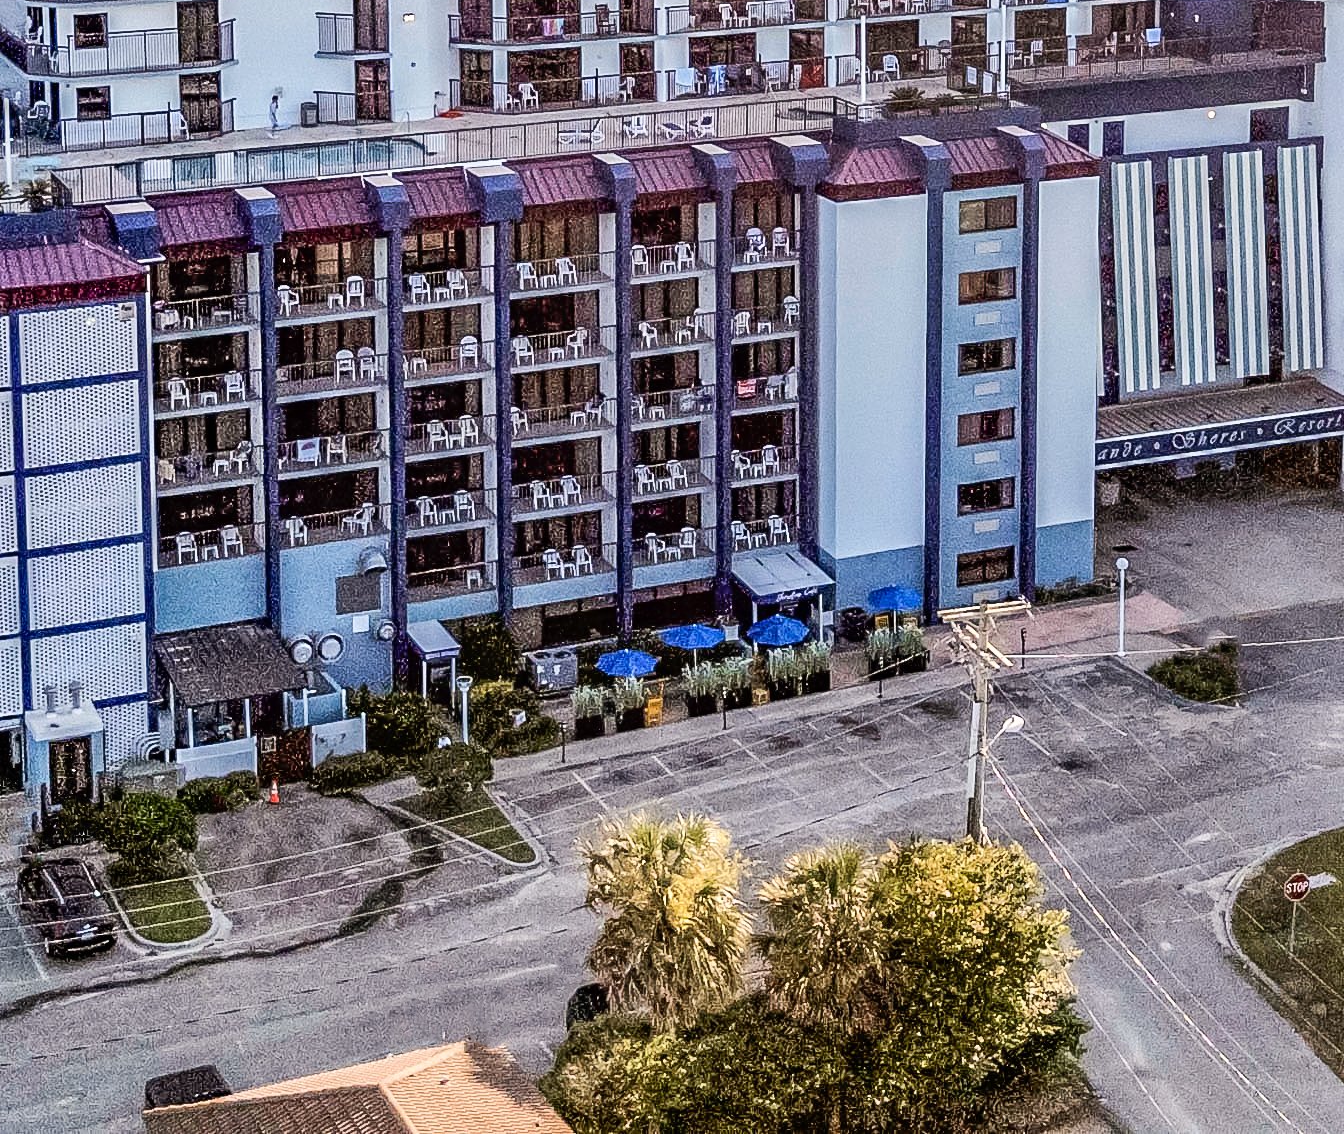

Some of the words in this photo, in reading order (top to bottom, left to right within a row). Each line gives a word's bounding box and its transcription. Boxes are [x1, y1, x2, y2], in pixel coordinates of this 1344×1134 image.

[1097, 441, 1143, 461] ande
[1171, 429, 1246, 449] Shores
[1273, 413, 1343, 435] Resort
[1286, 881, 1308, 894] STOP
